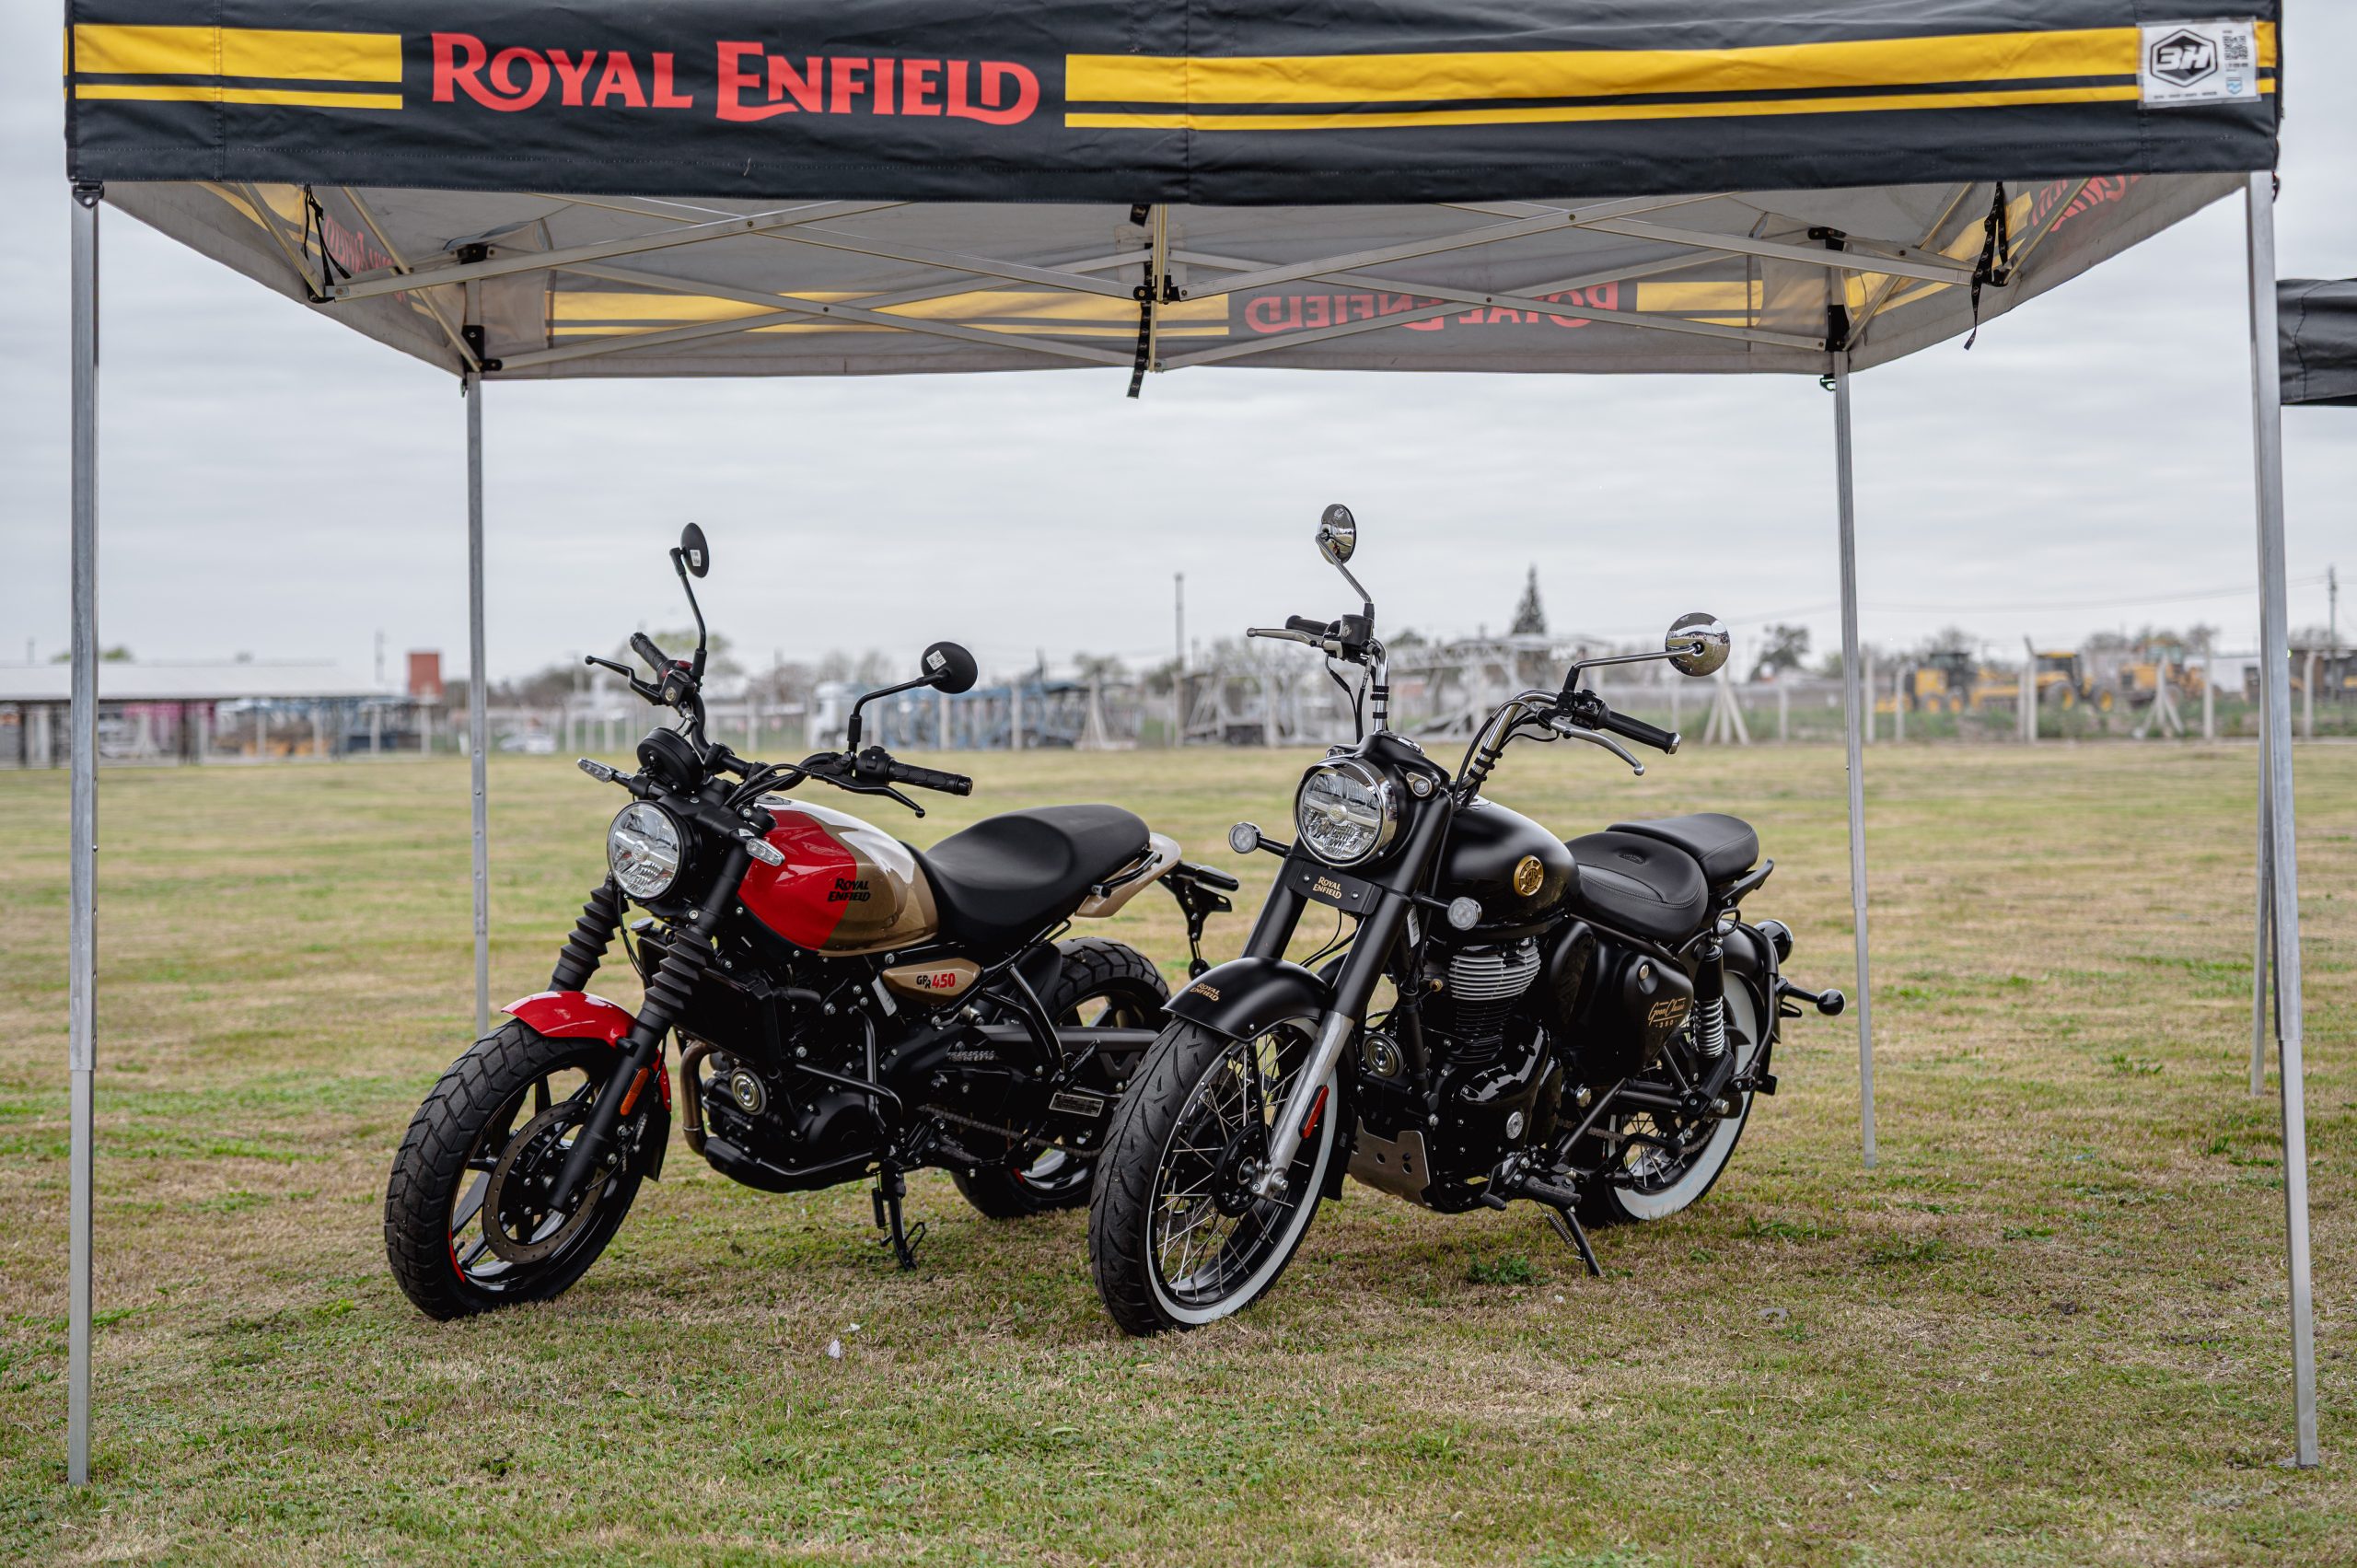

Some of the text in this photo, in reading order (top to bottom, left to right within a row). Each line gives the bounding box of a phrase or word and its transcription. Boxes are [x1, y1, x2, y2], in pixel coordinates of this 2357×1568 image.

[431, 32, 1040, 125] ROYAL ENFIELD
[834, 877, 869, 891] ROYAL
[1318, 876, 1341, 890] ROYAL
[827, 890, 871, 902] ENFIELD
[1312, 883, 1342, 900] ENFIELD
[931, 972, 957, 988] 450
[1190, 987, 1220, 1002] ENFIELD
[1197, 982, 1220, 996] ROYAL
